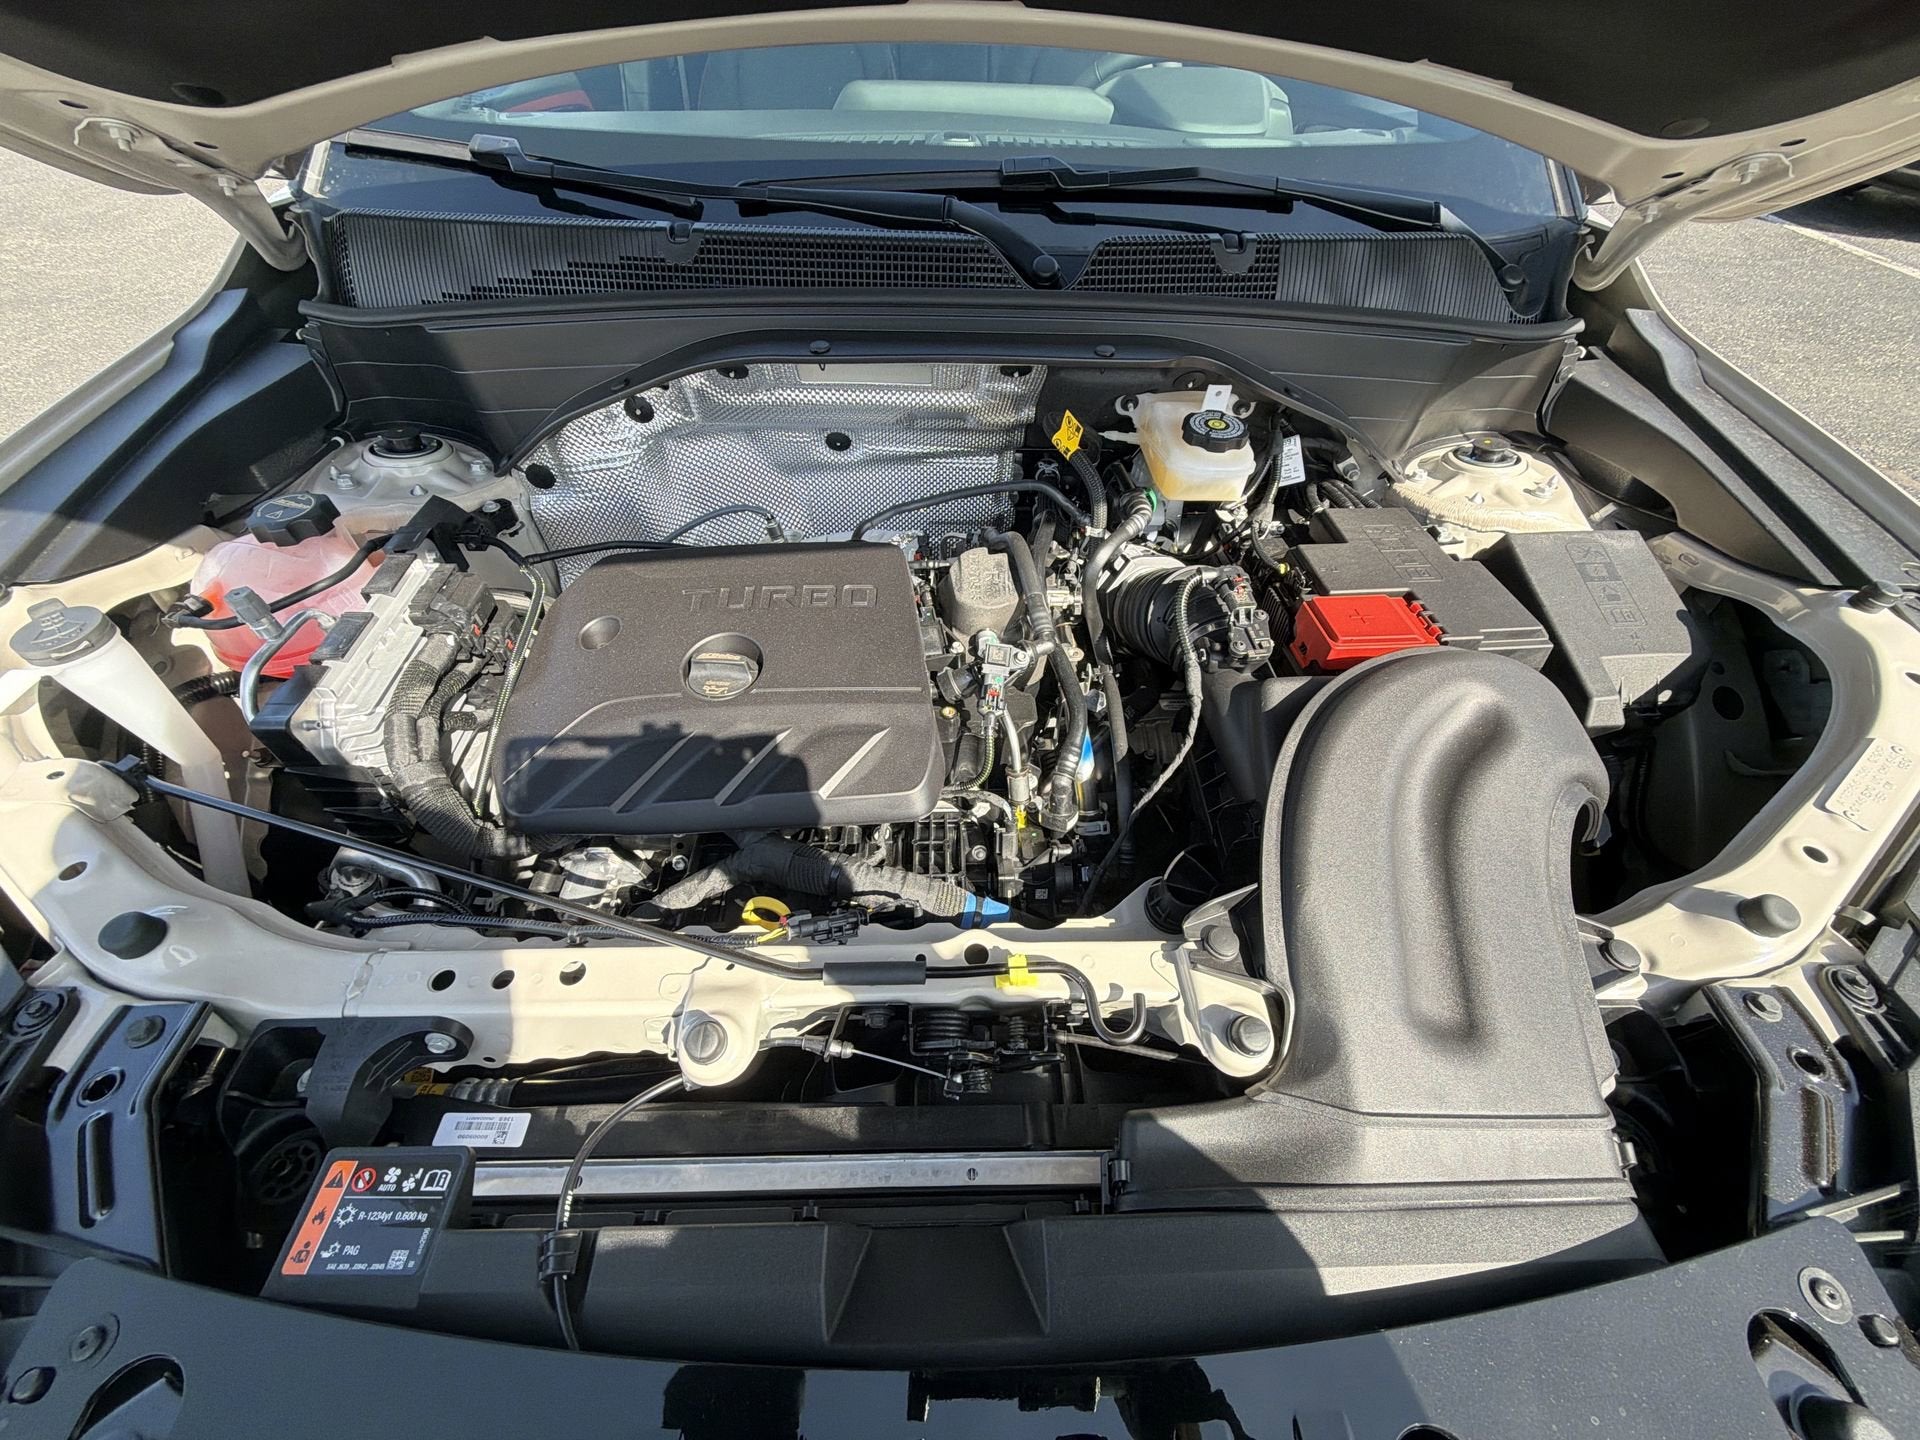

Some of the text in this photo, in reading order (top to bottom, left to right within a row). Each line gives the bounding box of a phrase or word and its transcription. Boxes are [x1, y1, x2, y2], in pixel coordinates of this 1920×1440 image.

[682, 584, 878, 611] TURBO
[376, 1183, 397, 1192] AUTO
[357, 1210, 429, 1223] R-1234yf 0.600 kg
[342, 1244, 361, 1256] PAG
